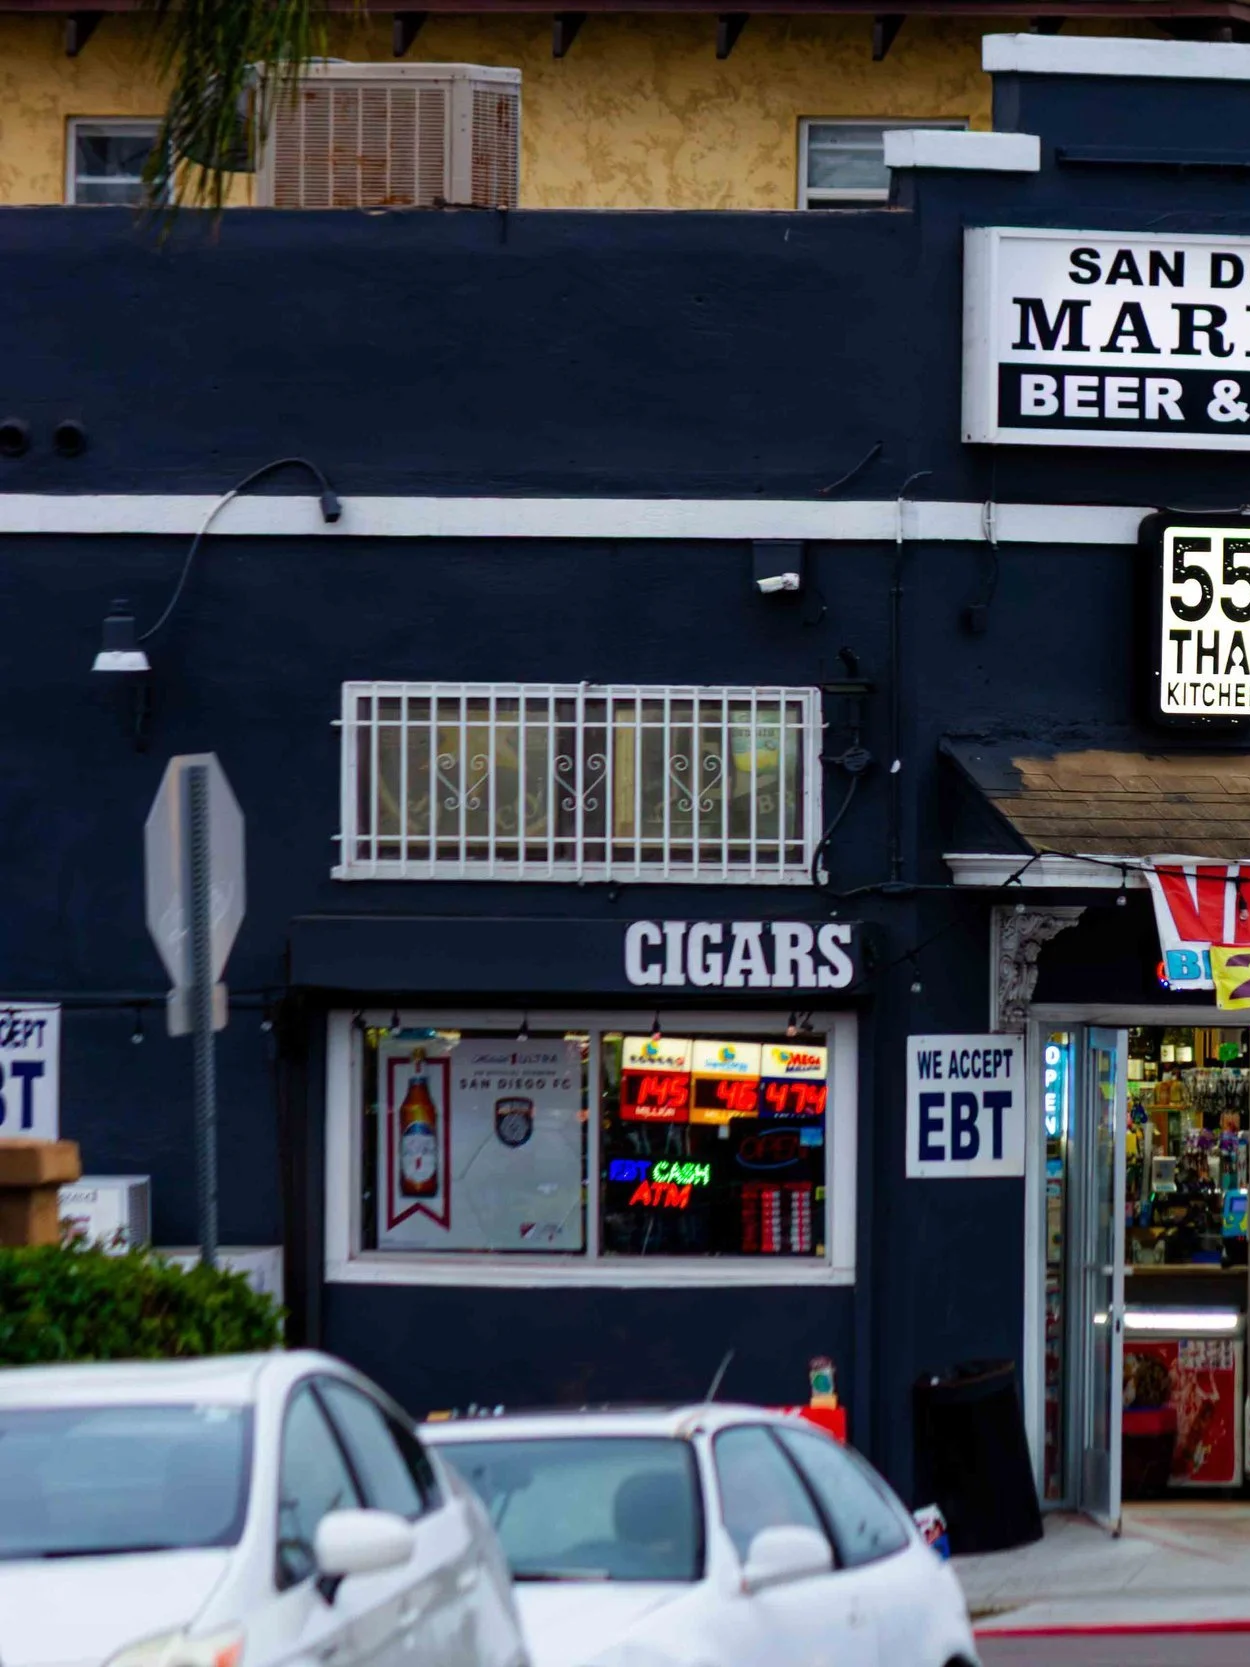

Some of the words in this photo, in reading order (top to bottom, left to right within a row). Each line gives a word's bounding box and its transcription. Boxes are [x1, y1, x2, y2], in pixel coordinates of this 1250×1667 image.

[1068, 246, 1185, 288] SAN
[1020, 374, 1184, 421] BEER
[1206, 379, 1250, 423] &
[625, 920, 853, 988] CIGARS
[917, 1050, 944, 1080] WE
[949, 1049, 1013, 1080] ACCEPT
[460, 1079, 490, 1090] SAN
[498, 1079, 546, 1090] DIEGO
[919, 1090, 1012, 1162] EBT
[609, 1159, 651, 1181] EBT
[653, 1160, 711, 1185] CASH
[629, 1180, 692, 1208] ATM
